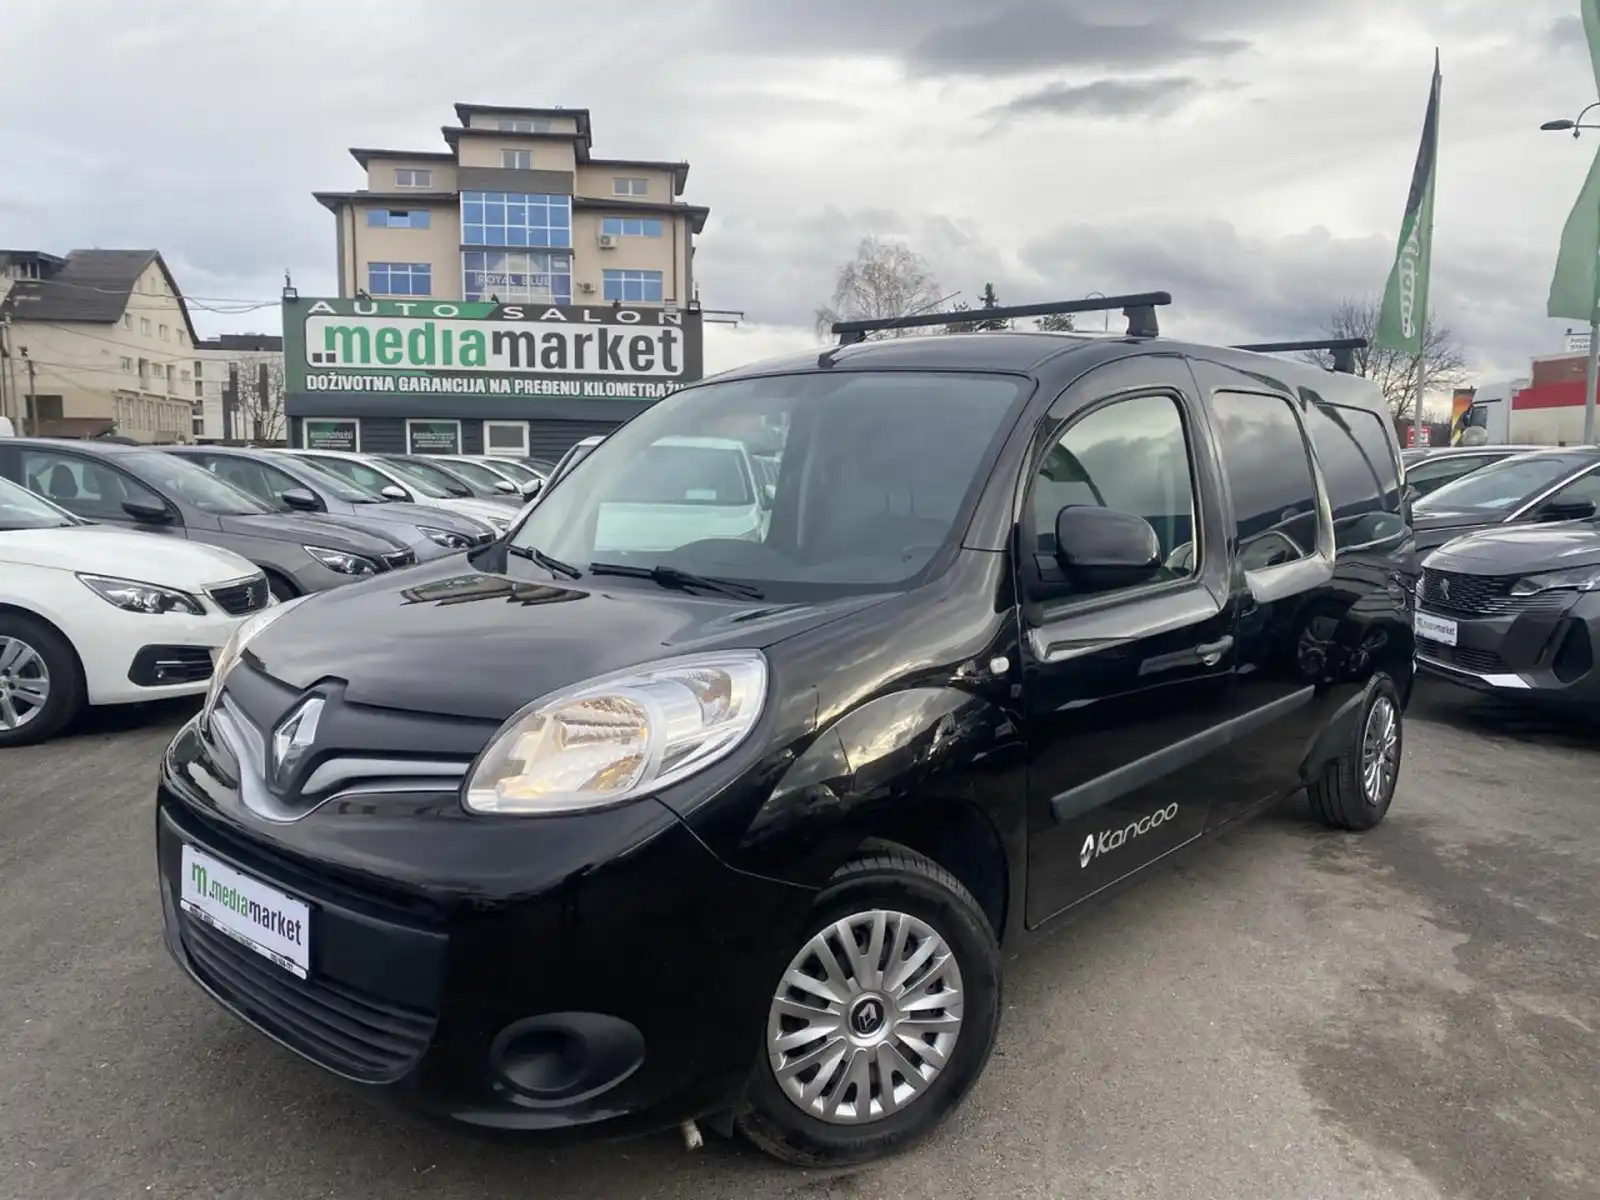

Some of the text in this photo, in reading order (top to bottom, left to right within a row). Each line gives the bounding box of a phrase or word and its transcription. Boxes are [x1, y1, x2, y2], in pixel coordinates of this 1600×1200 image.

[478, 275, 516, 285] ROYAL
[308, 301, 682, 324] AUTO SALON
[306, 372, 394, 391] DOŽIVOTNA
[399, 376, 485, 393] GARANCIJA
[490, 379, 510, 393] NA
[515, 379, 580, 396] PREĐENU
[1096, 802, 1178, 857] Kangoo
